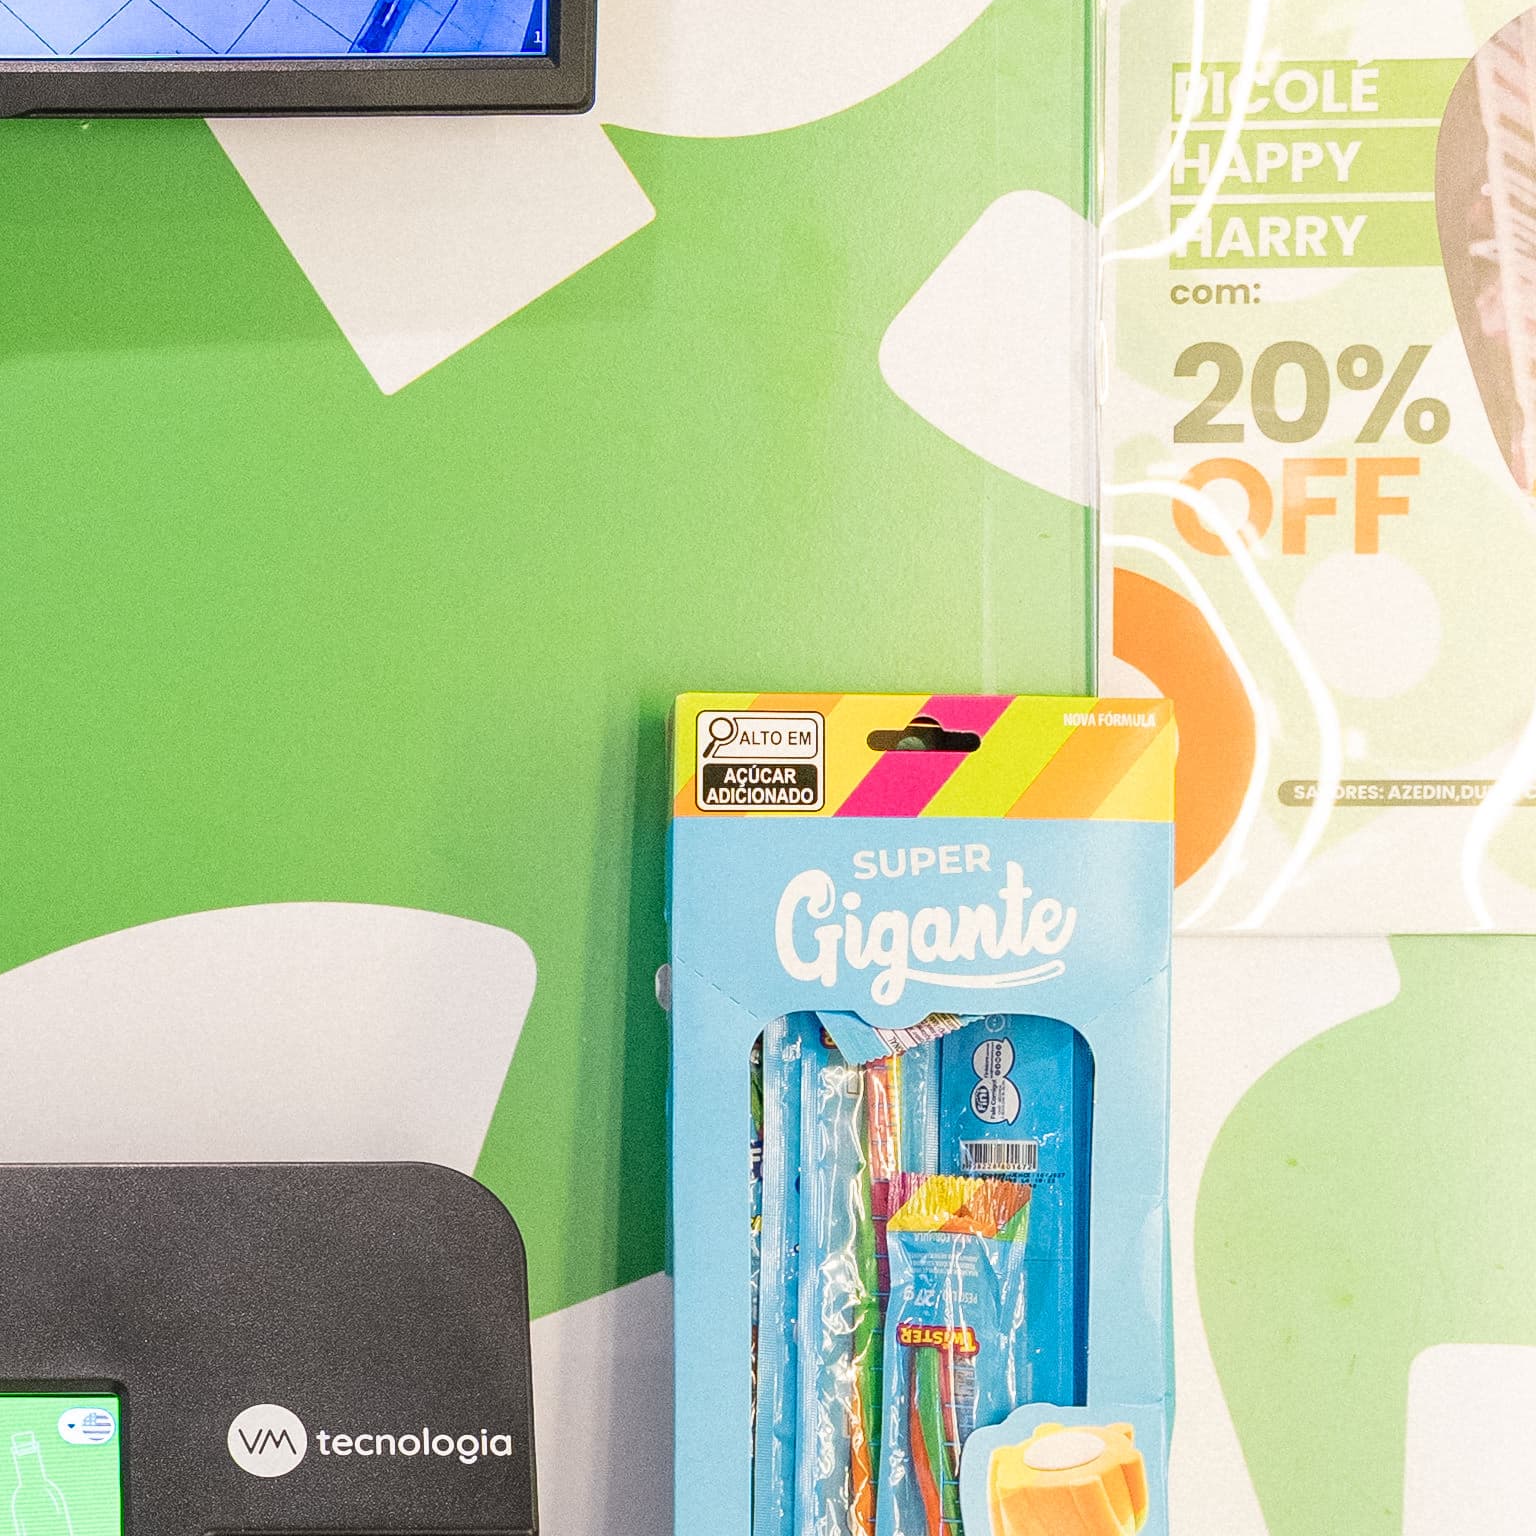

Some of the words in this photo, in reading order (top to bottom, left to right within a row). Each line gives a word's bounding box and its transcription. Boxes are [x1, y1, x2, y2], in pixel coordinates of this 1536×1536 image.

[1174, 141, 1362, 185] HAPPY
[1174, 215, 1368, 259] HARRY
[1170, 280, 1261, 306] com:
[1172, 340, 1452, 445] 20%
[1170, 457, 1421, 558] OFF
[1064, 713, 1096, 727] NOVA
[1098, 711, 1157, 727] FÓRMULA
[739, 730, 782, 746] ALTO
[787, 730, 812, 746] EM
[724, 764, 796, 789] AÇÚCAR
[1294, 784, 1384, 800] SAORES:
[706, 786, 814, 805] ADICIONADO
[852, 844, 992, 880] SUPER
[775, 861, 1077, 1006] Gigante
[238, 1428, 297, 1455] VM
[317, 1427, 513, 1464] tecnologia
